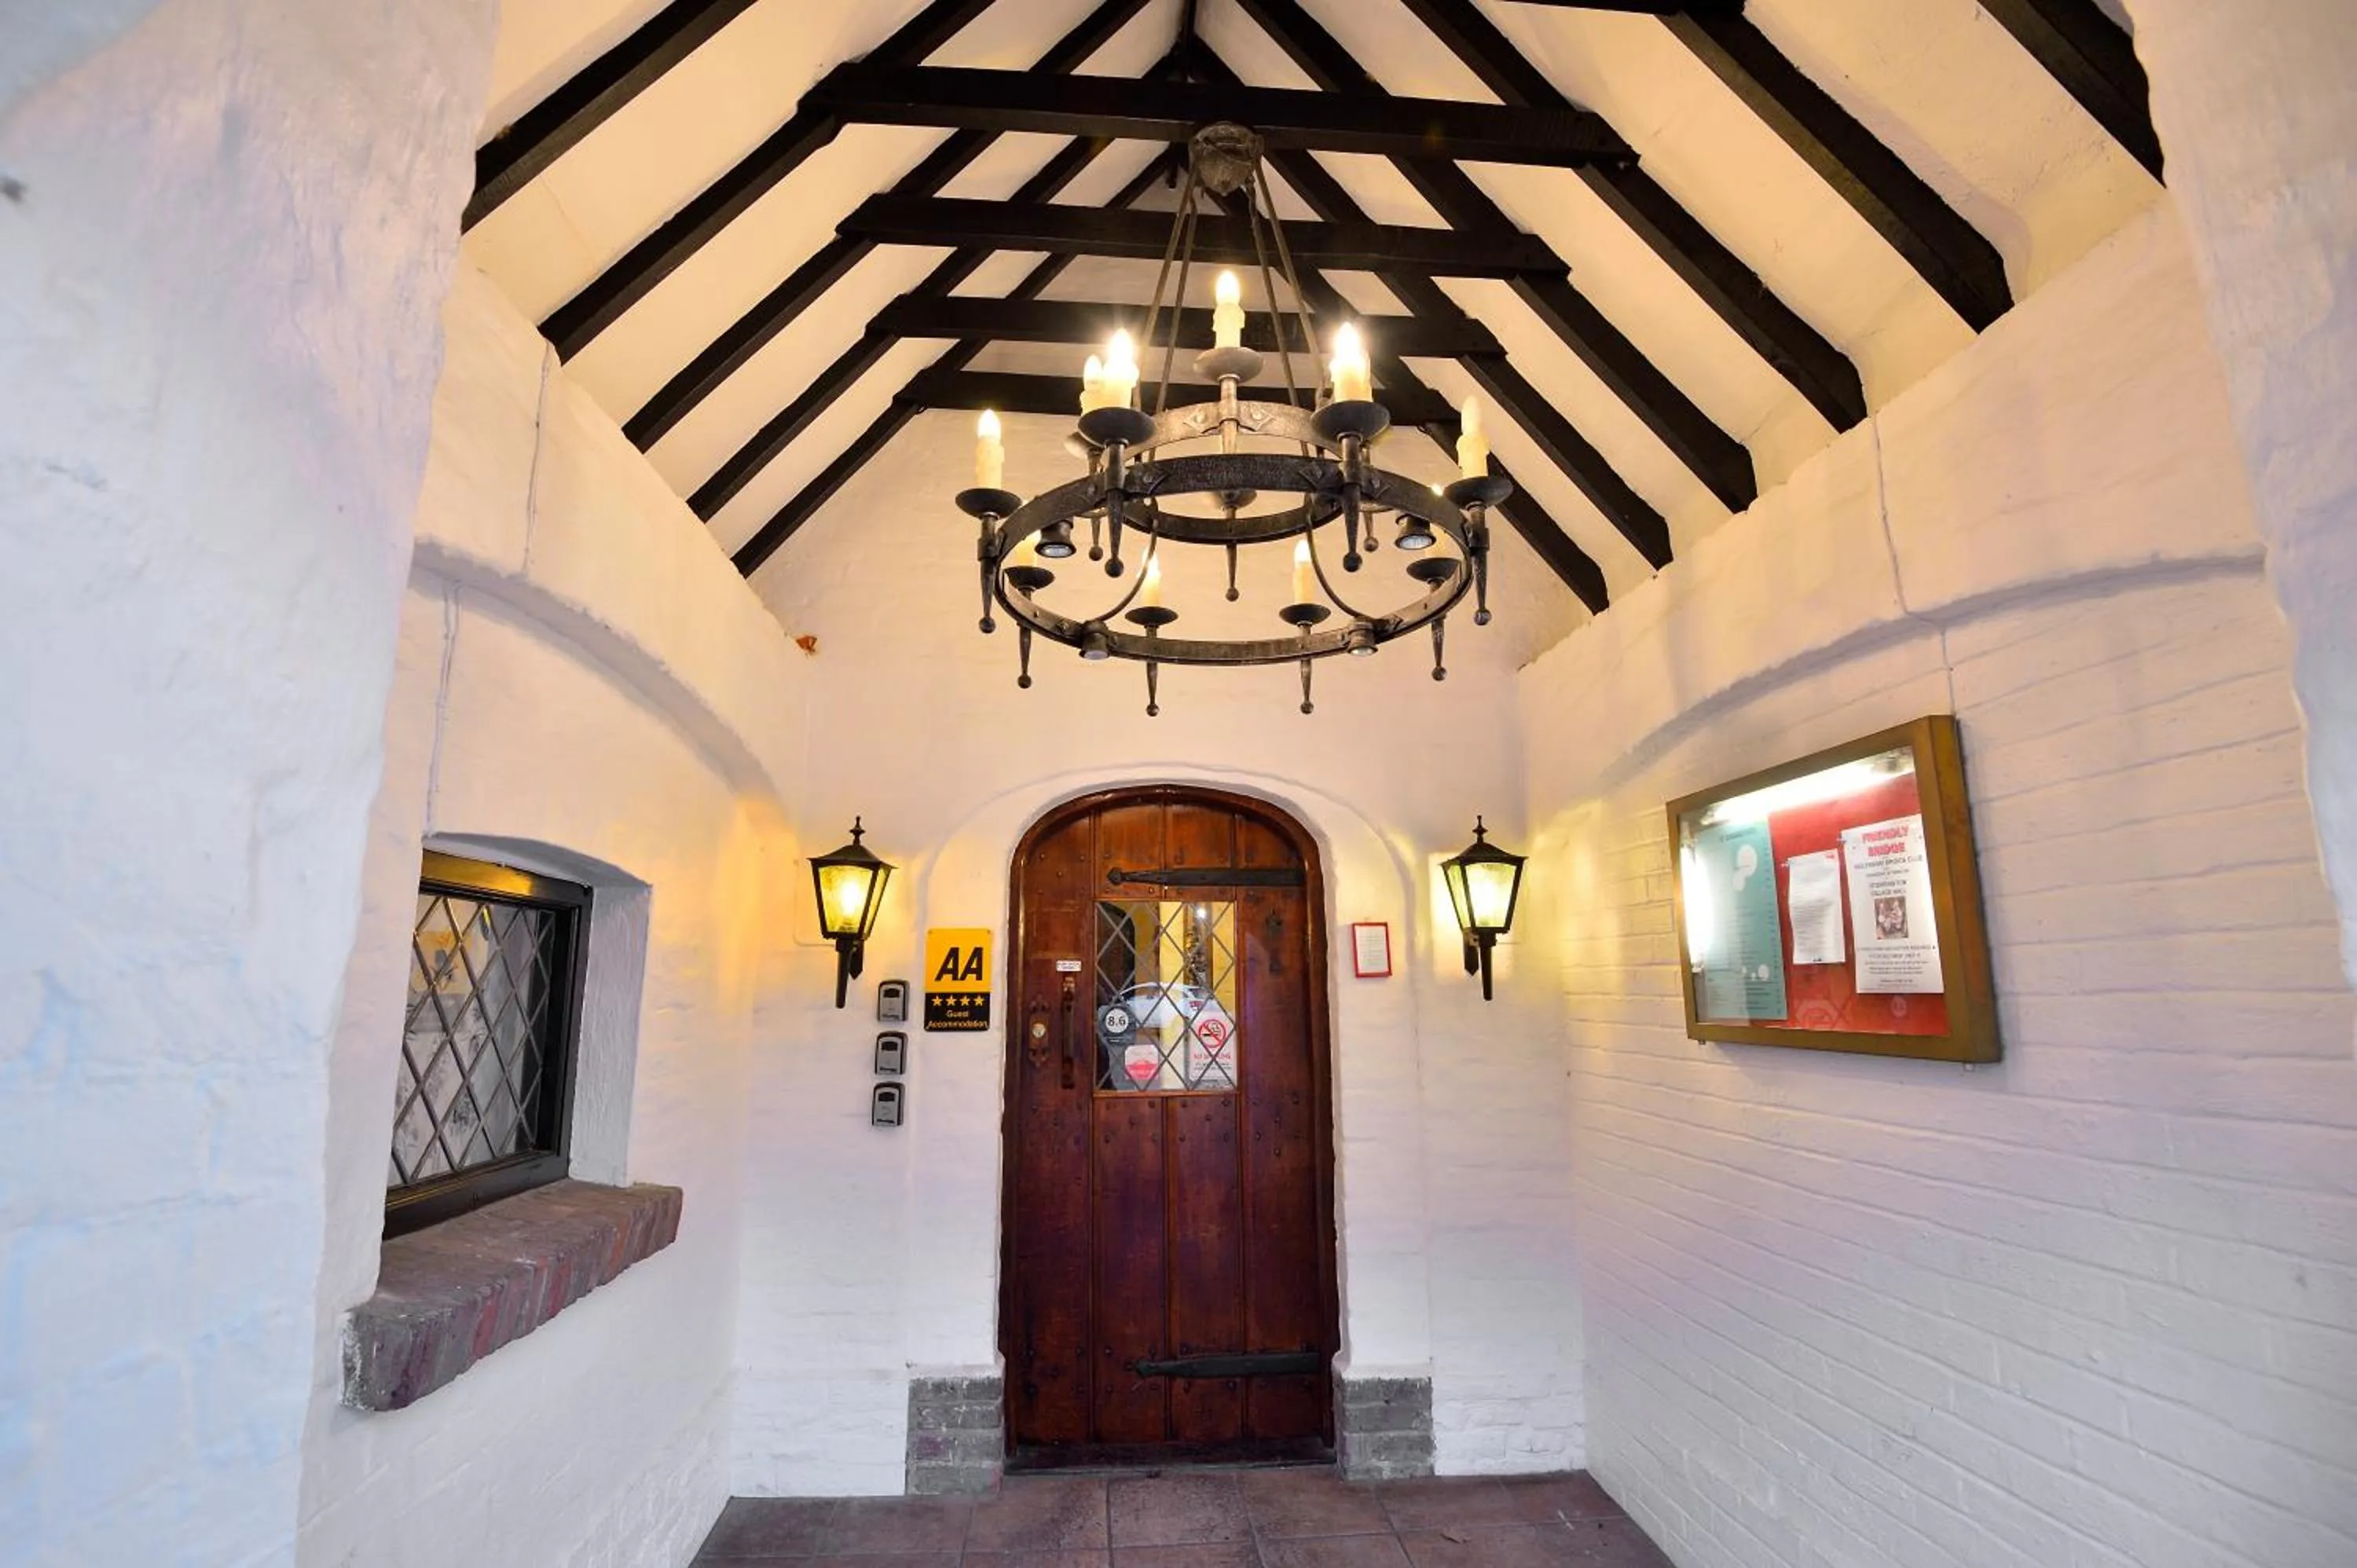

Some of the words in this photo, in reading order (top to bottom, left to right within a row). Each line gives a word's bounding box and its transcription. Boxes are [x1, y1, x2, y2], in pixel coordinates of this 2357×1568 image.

[934, 947, 984, 981] AA
[946, 1009, 969, 1018] Guest
[927, 1020, 988, 1029] Accommodation
[1107, 1016, 1127, 1027] 8.6
